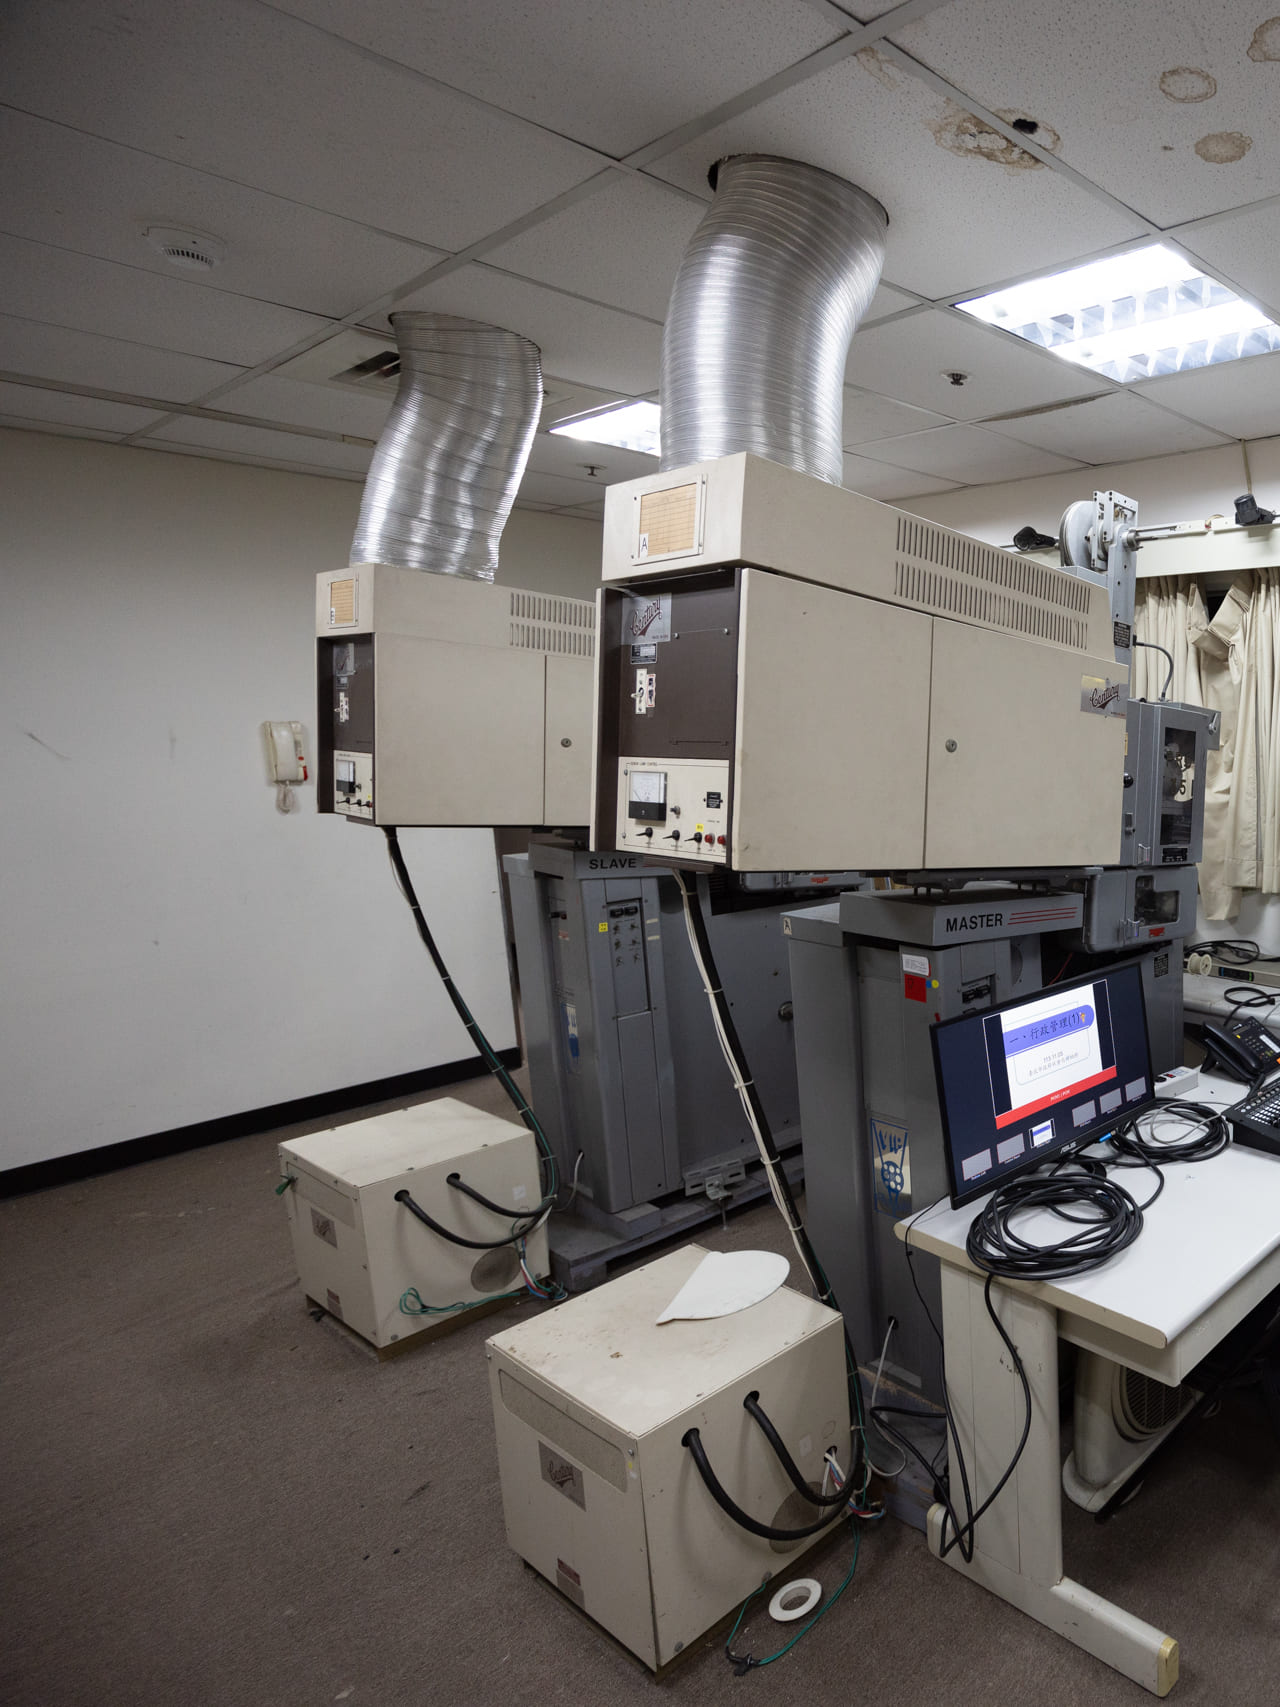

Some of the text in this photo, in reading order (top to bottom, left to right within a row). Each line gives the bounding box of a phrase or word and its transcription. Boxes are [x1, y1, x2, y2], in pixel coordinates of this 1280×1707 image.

[641, 537, 648, 552] A
[589, 858, 637, 870] SLAVE
[946, 913, 1004, 933] MASTER
